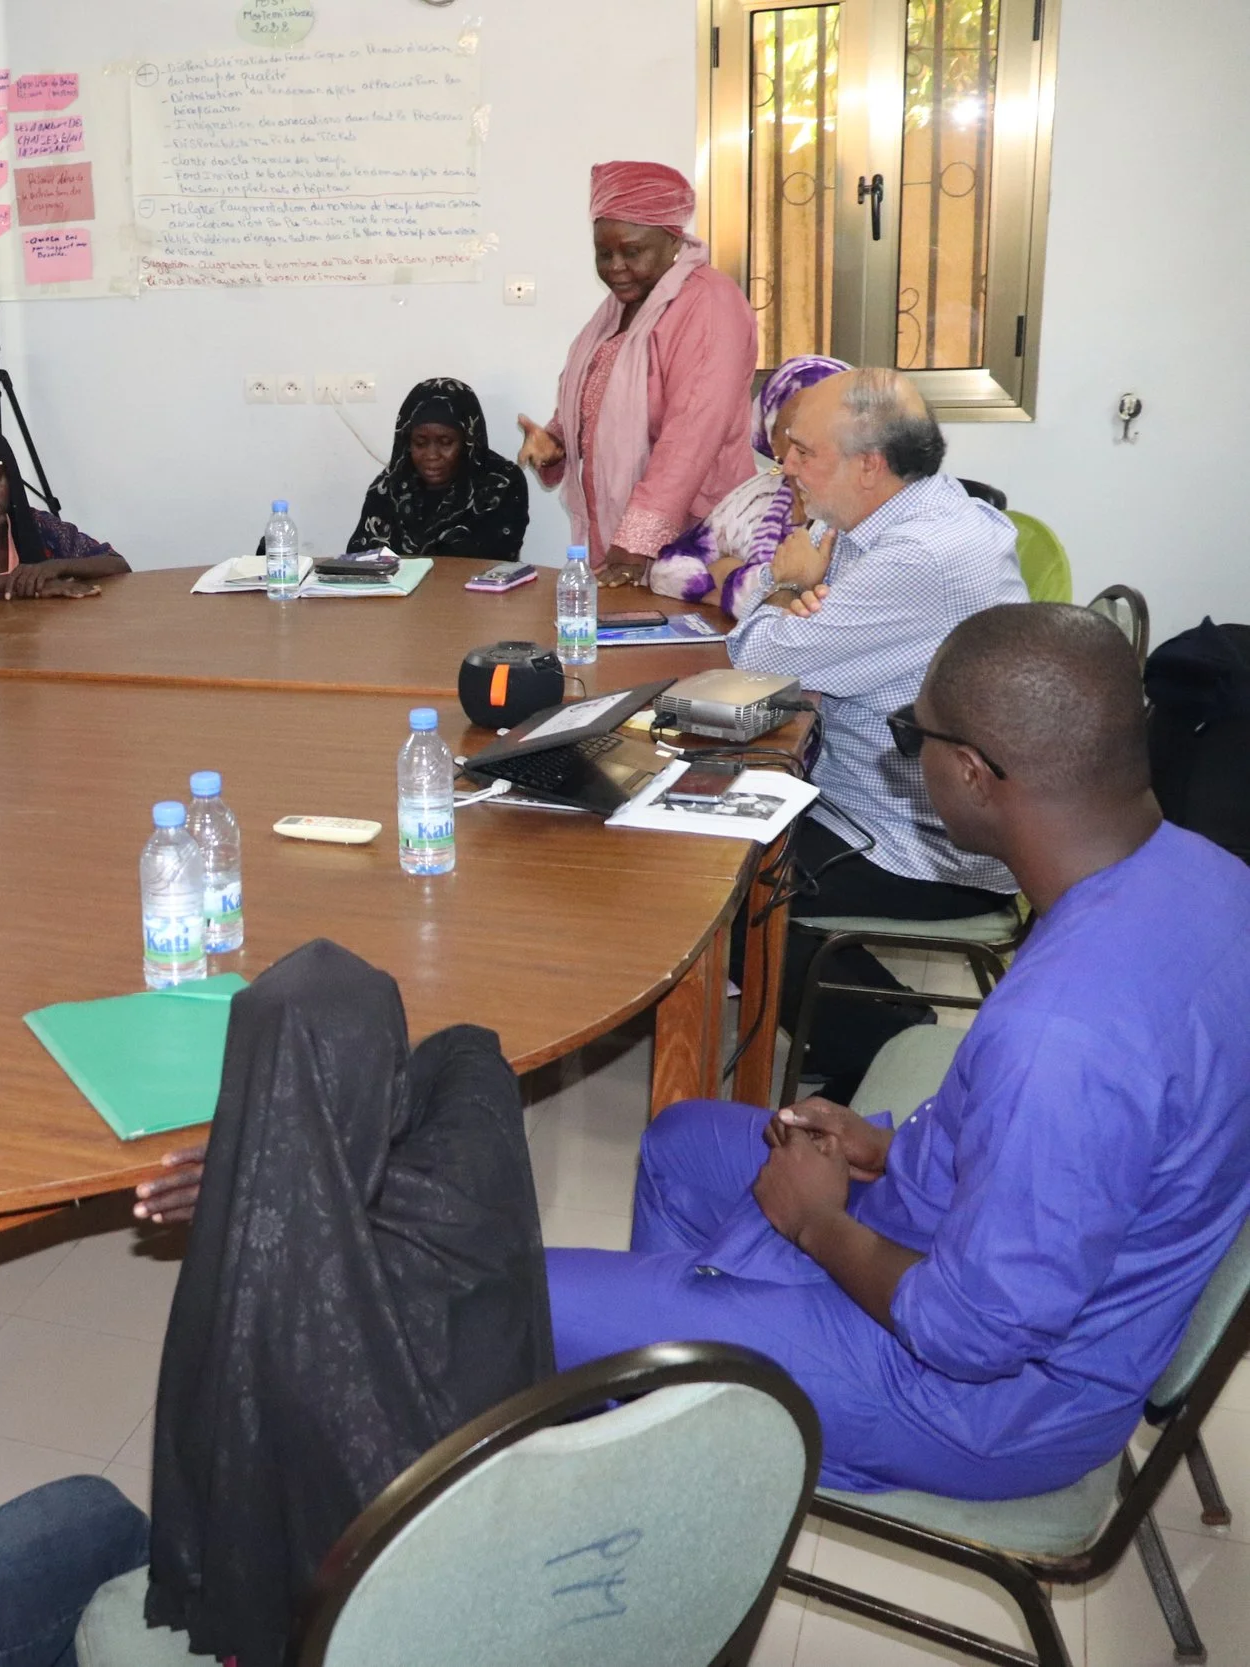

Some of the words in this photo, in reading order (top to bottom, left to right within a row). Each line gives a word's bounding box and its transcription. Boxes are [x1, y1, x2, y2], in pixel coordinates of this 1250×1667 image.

[561, 621, 589, 639] Kati
[221, 893, 242, 912] Ka
[145, 926, 190, 953] Kati
